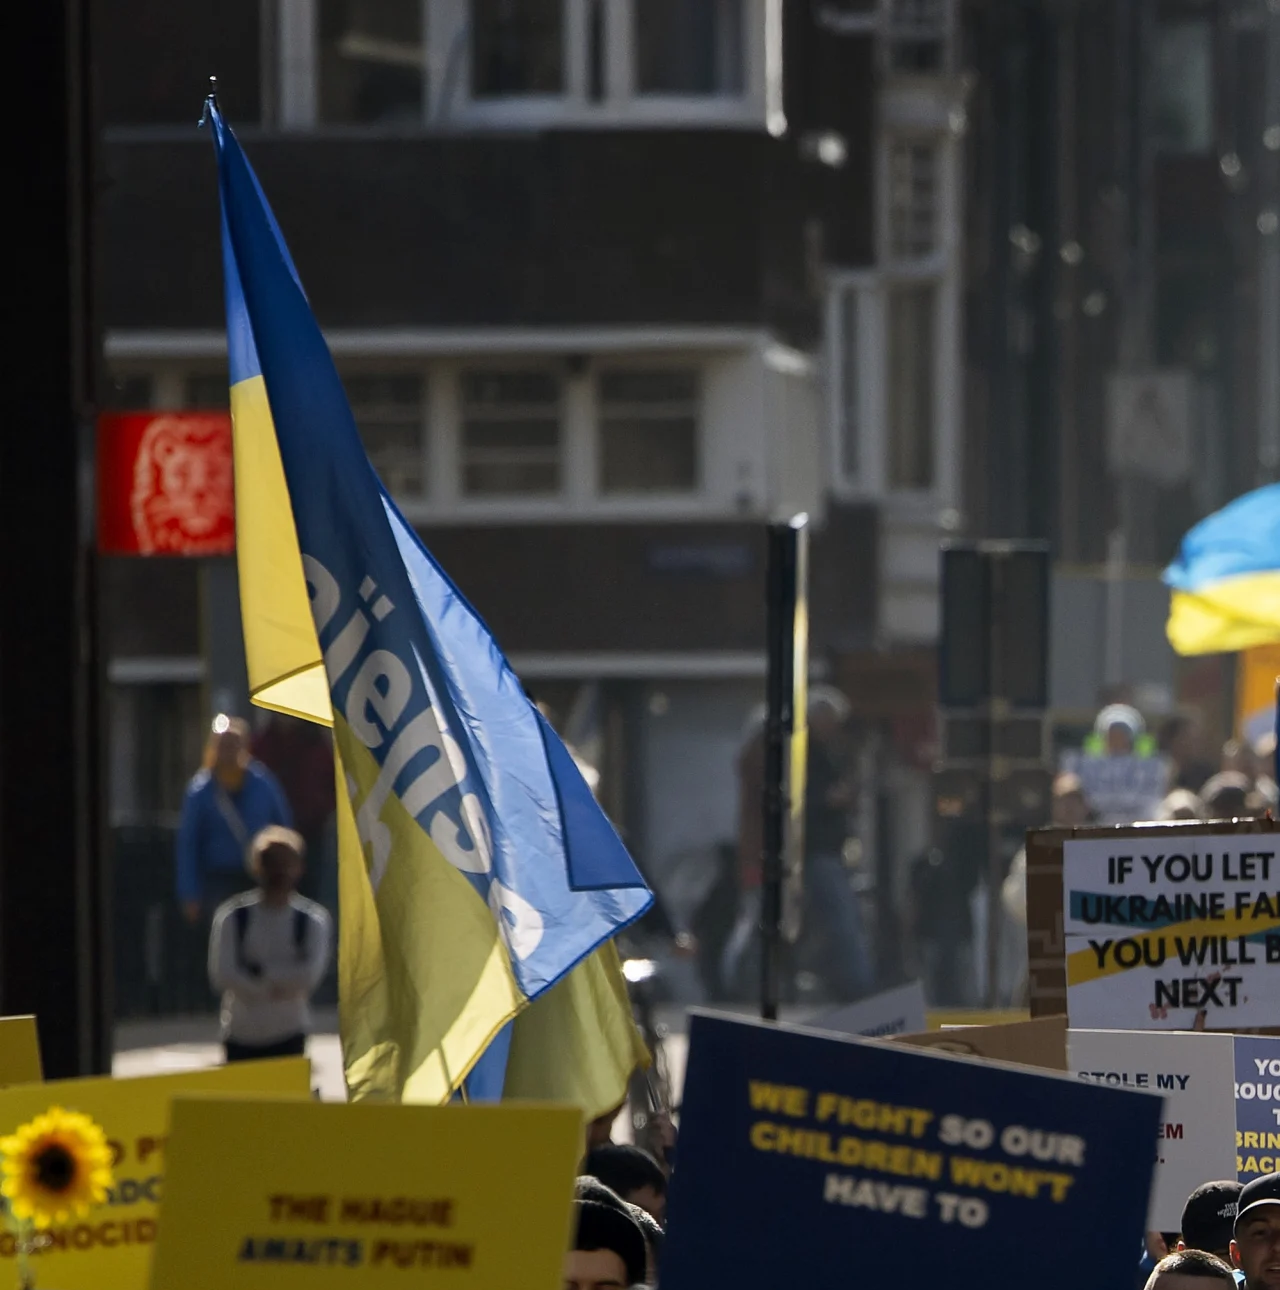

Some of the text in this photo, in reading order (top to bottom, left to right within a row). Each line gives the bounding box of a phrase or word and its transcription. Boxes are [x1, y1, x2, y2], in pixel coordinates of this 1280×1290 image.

[1107, 851, 1276, 885] IF YOU LET
[1079, 891, 1226, 925] UKRAINE
[1086, 936, 1168, 970] YOU
[1173, 933, 1256, 967] WILL
[1153, 976, 1243, 1010] NEXT
[1157, 1073, 1190, 1091] MY
[749, 1079, 1087, 1167] WE FIGHT SO OUR
[750, 1120, 1075, 1203] CHILDREN WON'T
[267, 1192, 457, 1229] THE HAGUE
[823, 1172, 990, 1230] HAVE TO
[236, 1235, 476, 1271] AWAITS PUTIN
